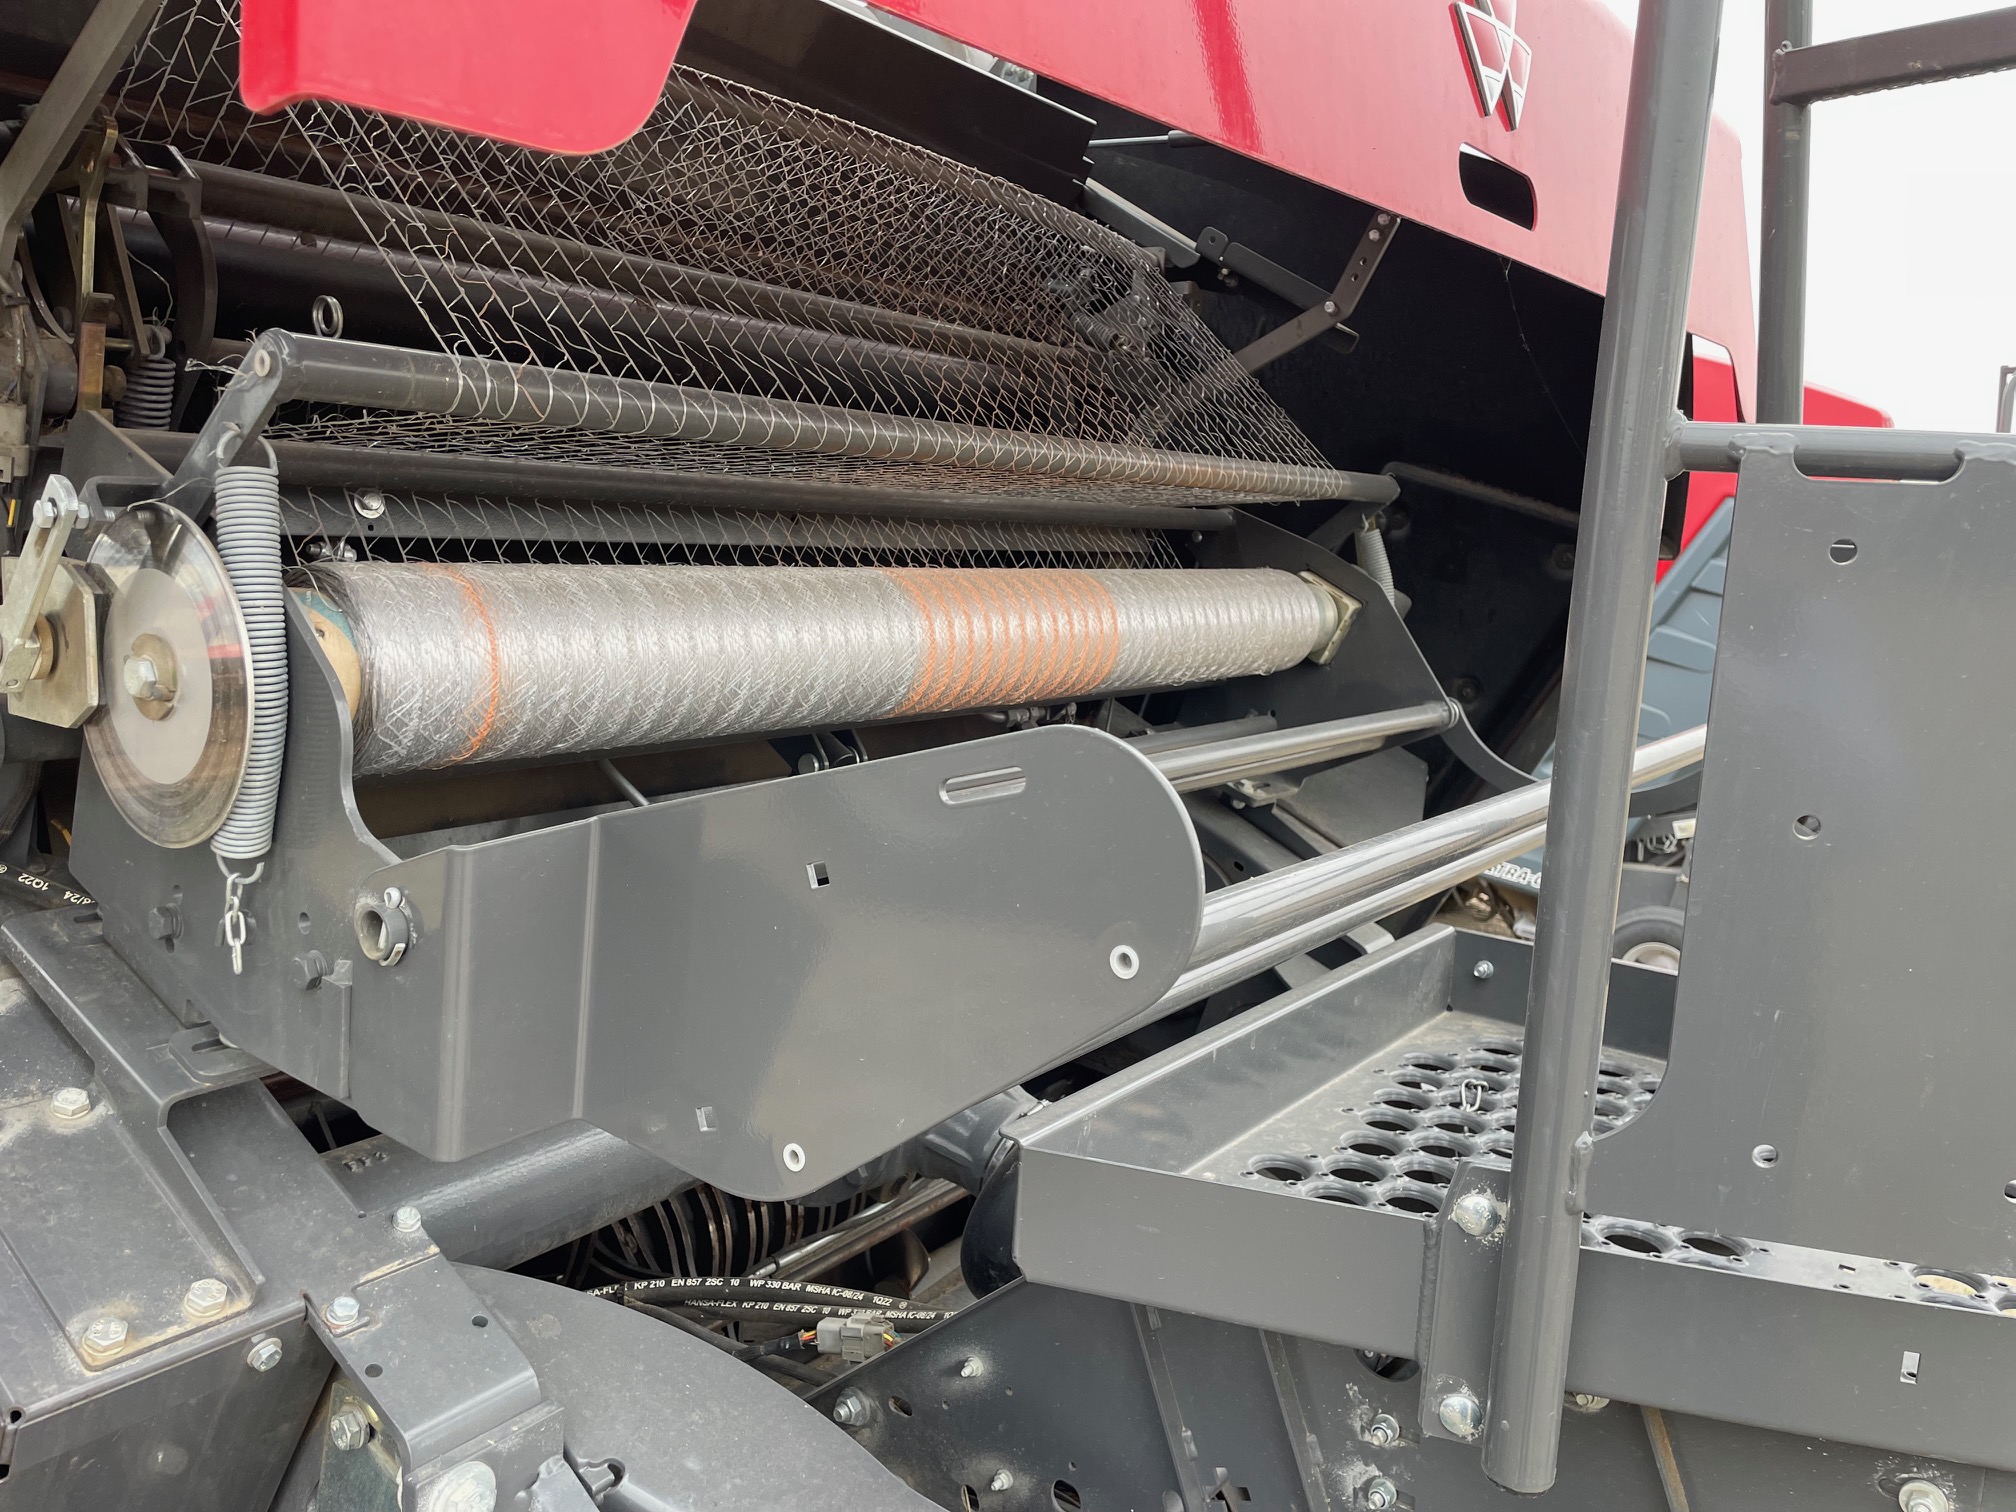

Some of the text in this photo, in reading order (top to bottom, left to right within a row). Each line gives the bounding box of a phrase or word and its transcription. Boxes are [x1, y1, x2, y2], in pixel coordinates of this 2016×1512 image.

[18, 873, 49, 891] 1Q22
[634, 1281, 649, 1290] KP
[649, 1280, 665, 1288] 210
[671, 1279, 685, 1287] EN
[686, 1278, 703, 1286] 857
[705, 1278, 724, 1286] 2SC
[730, 1278, 740, 1286] 10
[749, 1279, 765, 1288] WP
[765, 1280, 781, 1289] 330
[781, 1281, 802, 1291] BAR
[805, 1284, 831, 1295] MSHA
[872, 1296, 893, 1307] 1Q22
[742, 1301, 755, 1309] KP
[755, 1302, 769, 1310] 210
[773, 1302, 786, 1311] EN
[801, 1305, 818, 1314] 2SC
[822, 1306, 832, 1315] 10
[838, 1308, 852, 1316] WP
